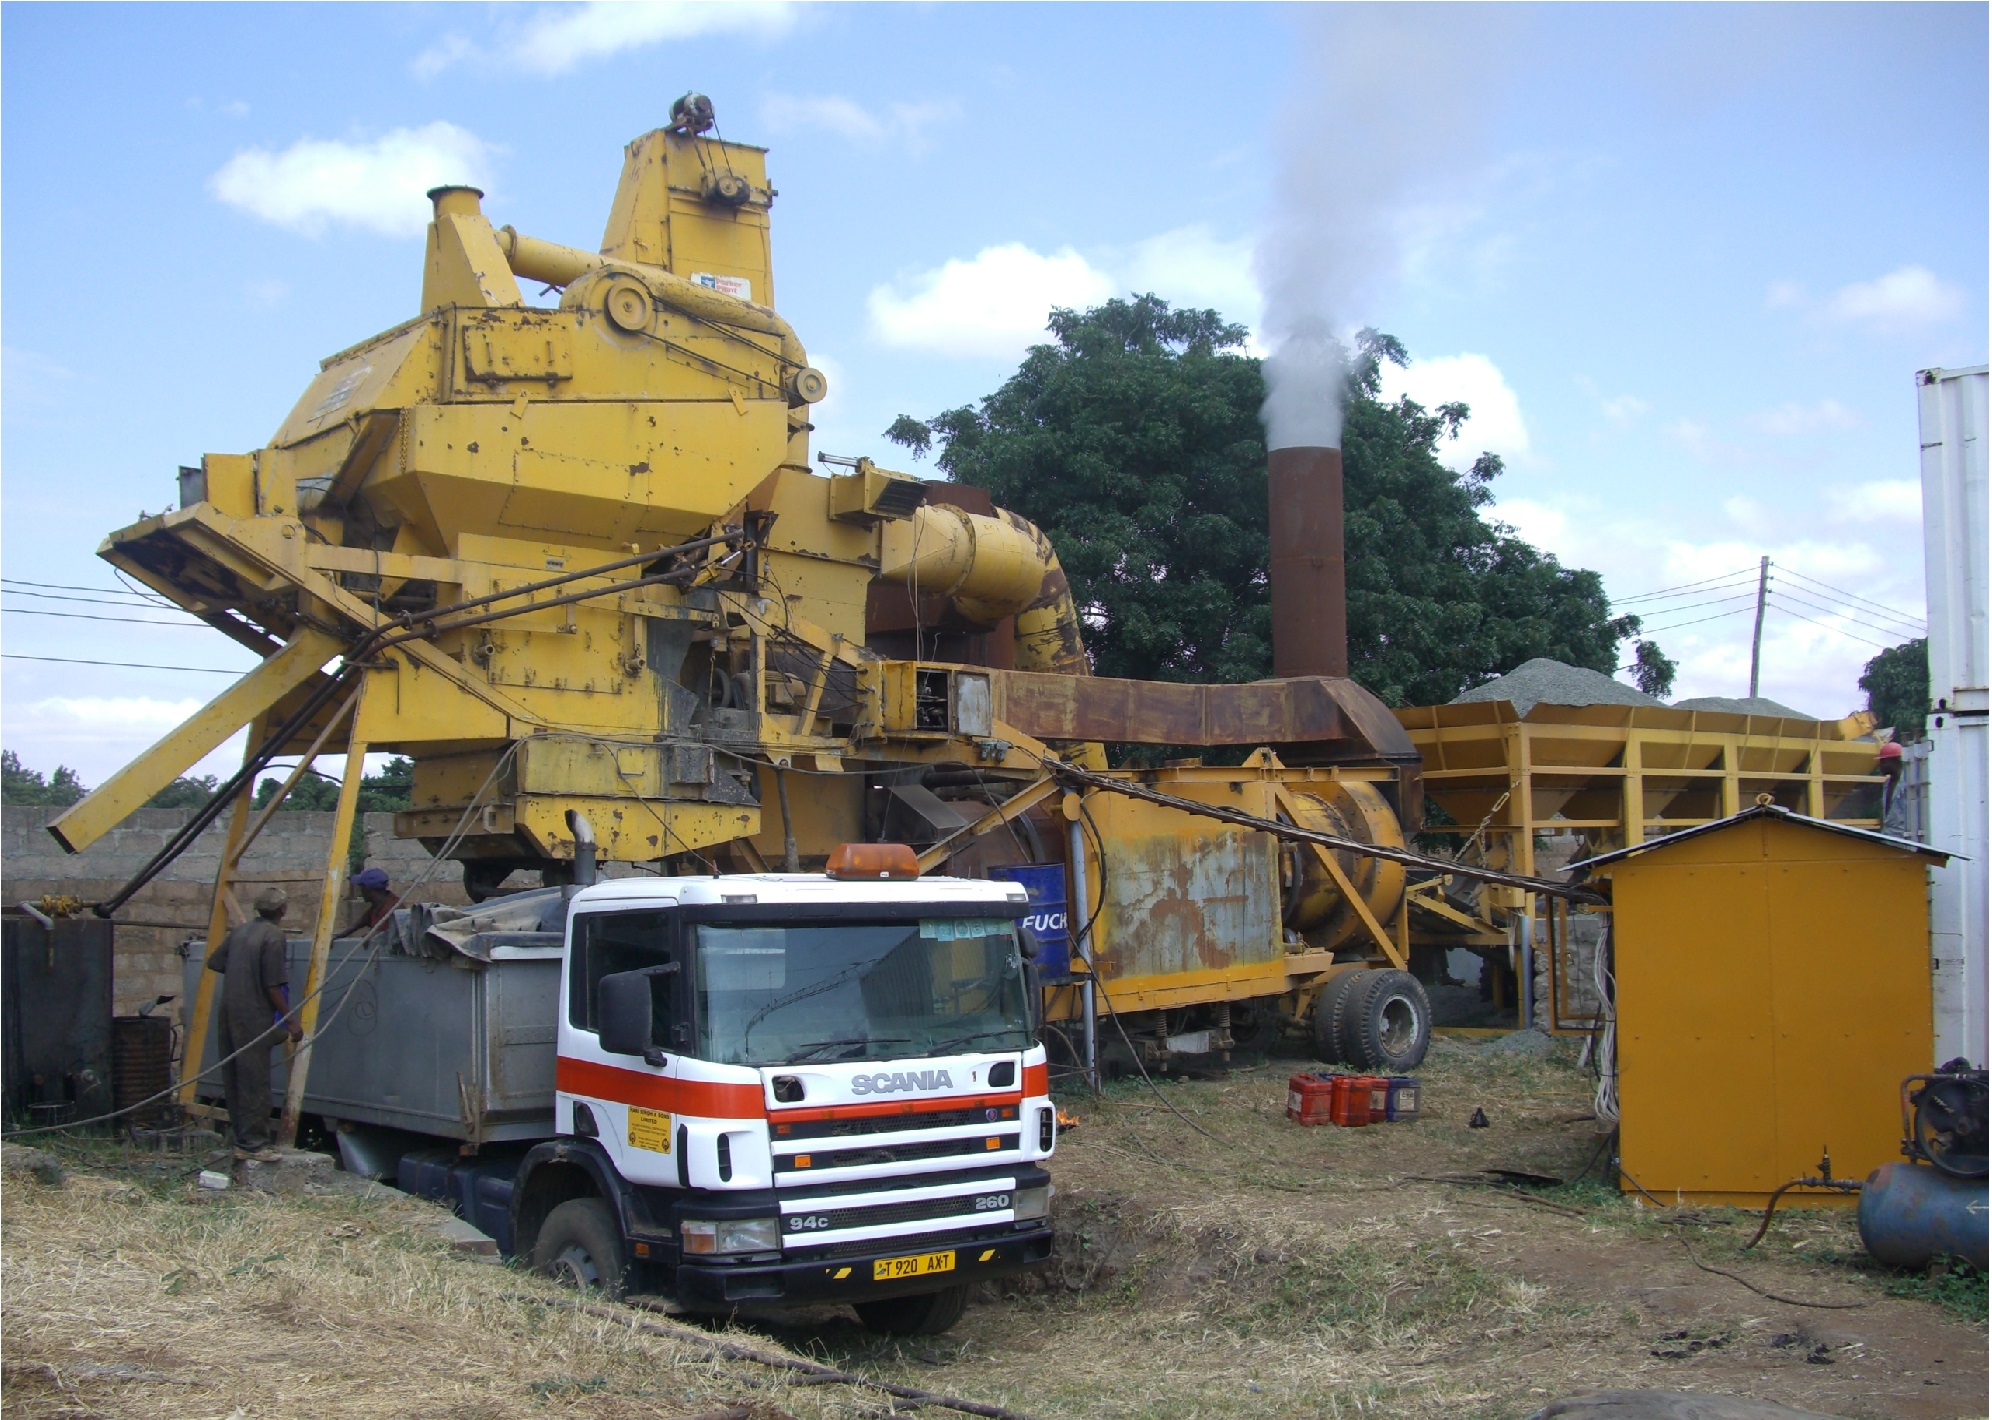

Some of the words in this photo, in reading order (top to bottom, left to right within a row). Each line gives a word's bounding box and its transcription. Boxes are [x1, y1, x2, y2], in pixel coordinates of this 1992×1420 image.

[851, 1069, 954, 1096] SCANIA
[975, 1194, 1009, 1210] 260
[885, 1261, 892, 1277] T
[895, 1258, 918, 1276] 920
[927, 1254, 949, 1271] AXT
